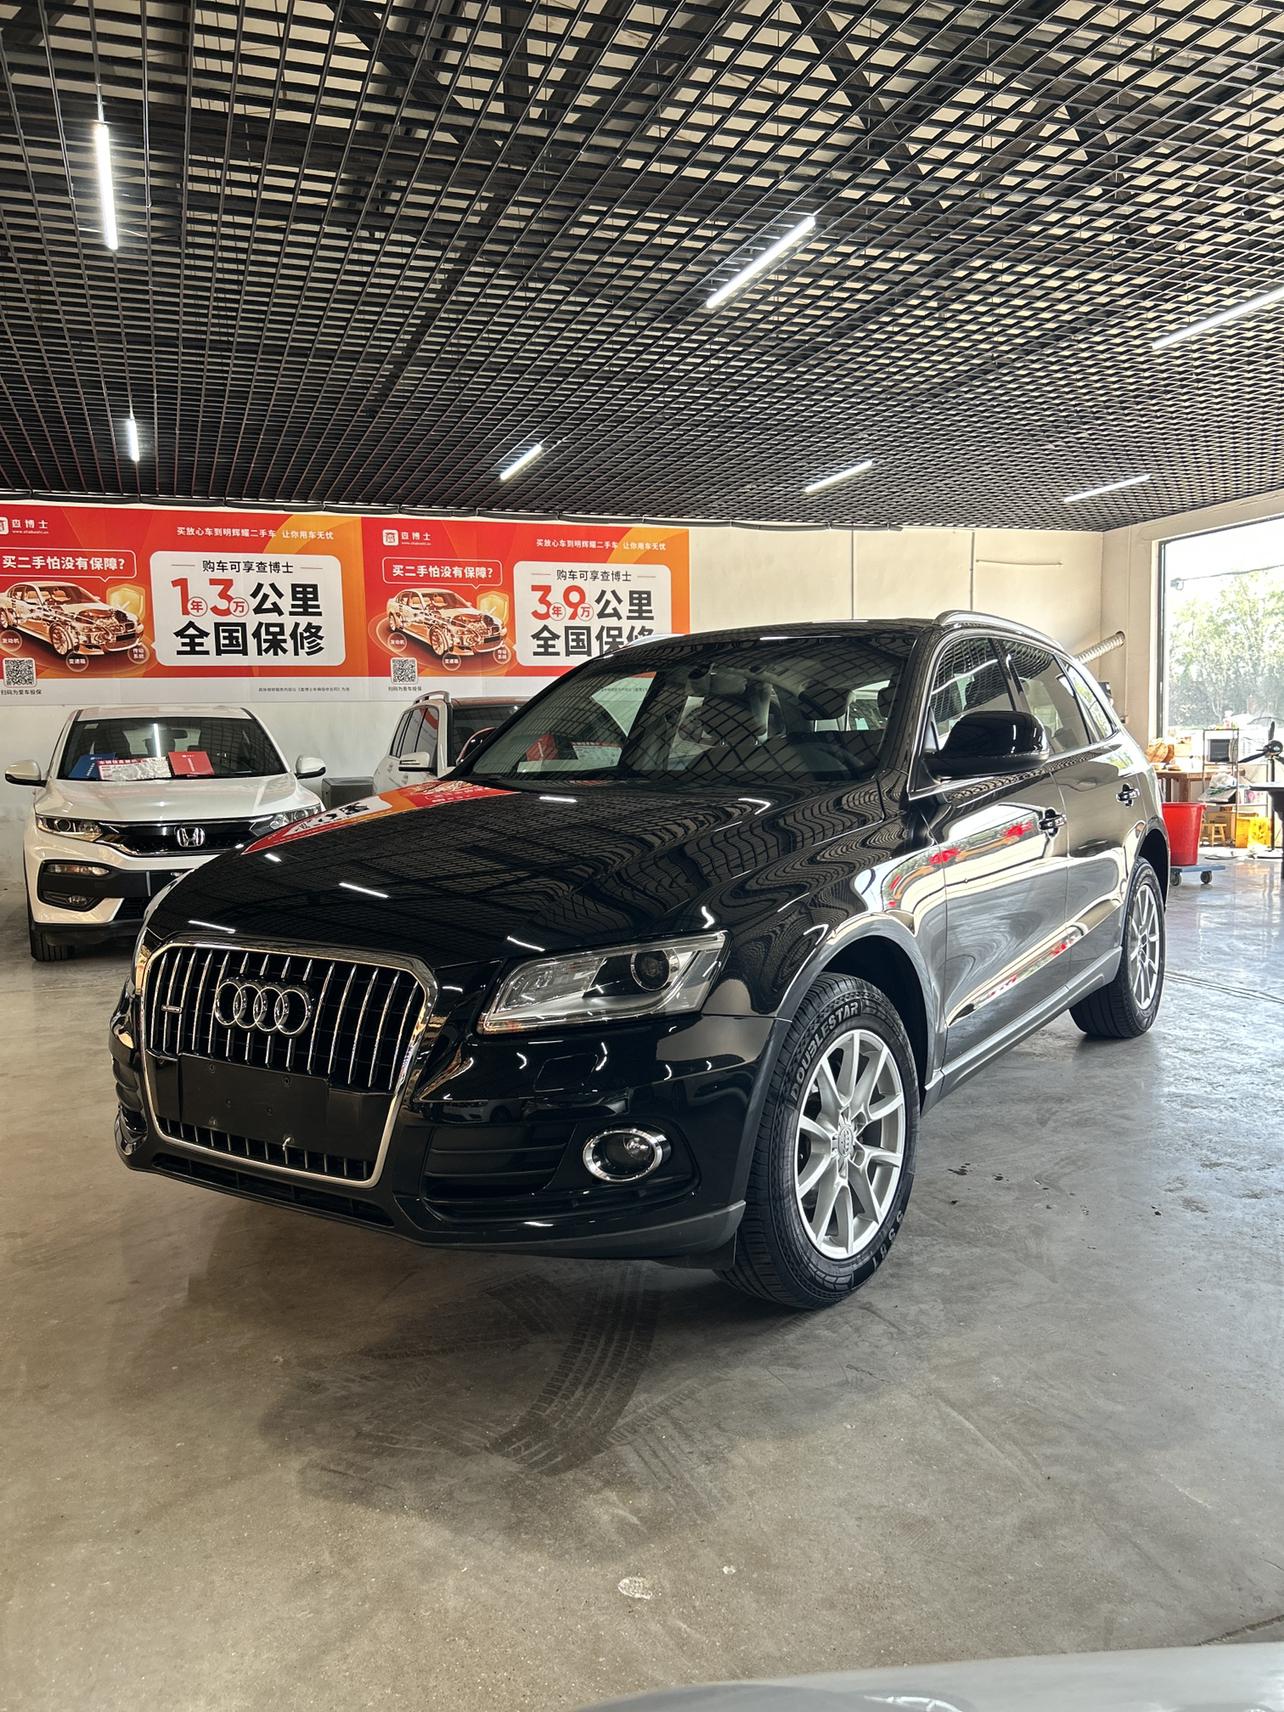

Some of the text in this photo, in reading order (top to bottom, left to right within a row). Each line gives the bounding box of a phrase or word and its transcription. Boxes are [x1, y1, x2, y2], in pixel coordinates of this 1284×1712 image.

[282, 530, 334, 541] 让你用车无忧
[202, 560, 294, 574] 购车可享查博士
[556, 569, 632, 582] 购车可享查博士
[173, 620, 325, 657] 全国保修
[790, 1001, 860, 1101] DOUBLESTAR
